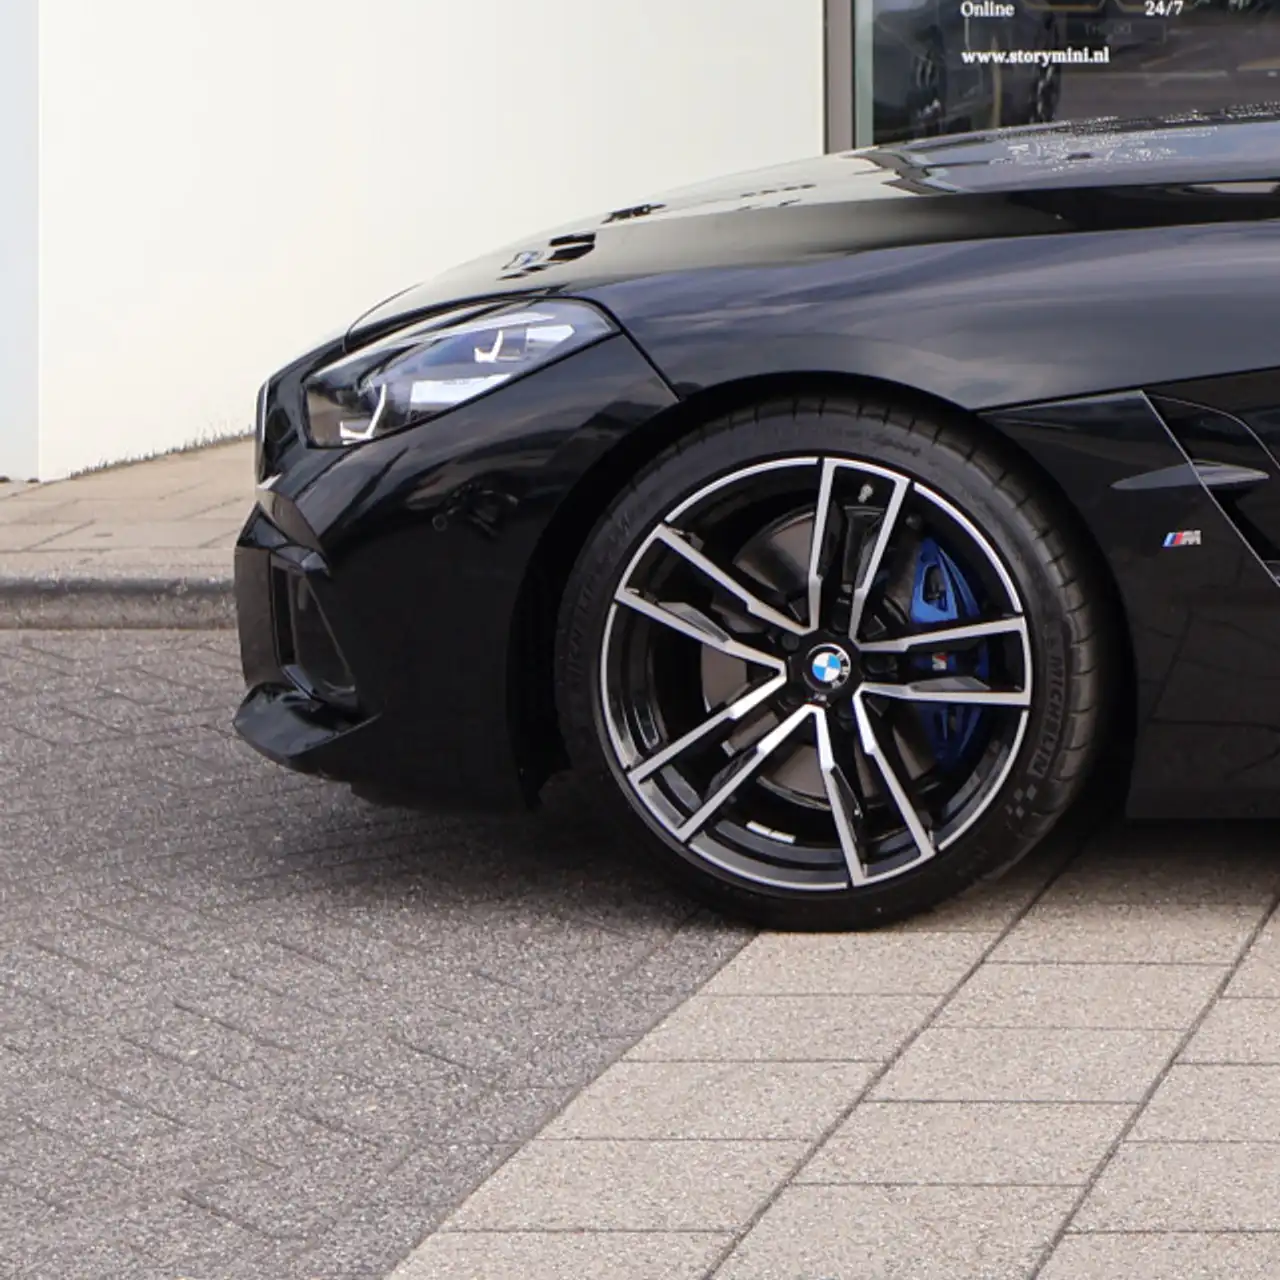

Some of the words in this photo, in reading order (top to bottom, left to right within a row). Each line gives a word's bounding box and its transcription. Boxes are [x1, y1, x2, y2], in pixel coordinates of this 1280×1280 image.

[960, 0, 1015, 17] Online
[1144, 0, 1184, 17] 24/7
[960, 45, 1111, 65] www.storymini.nl
